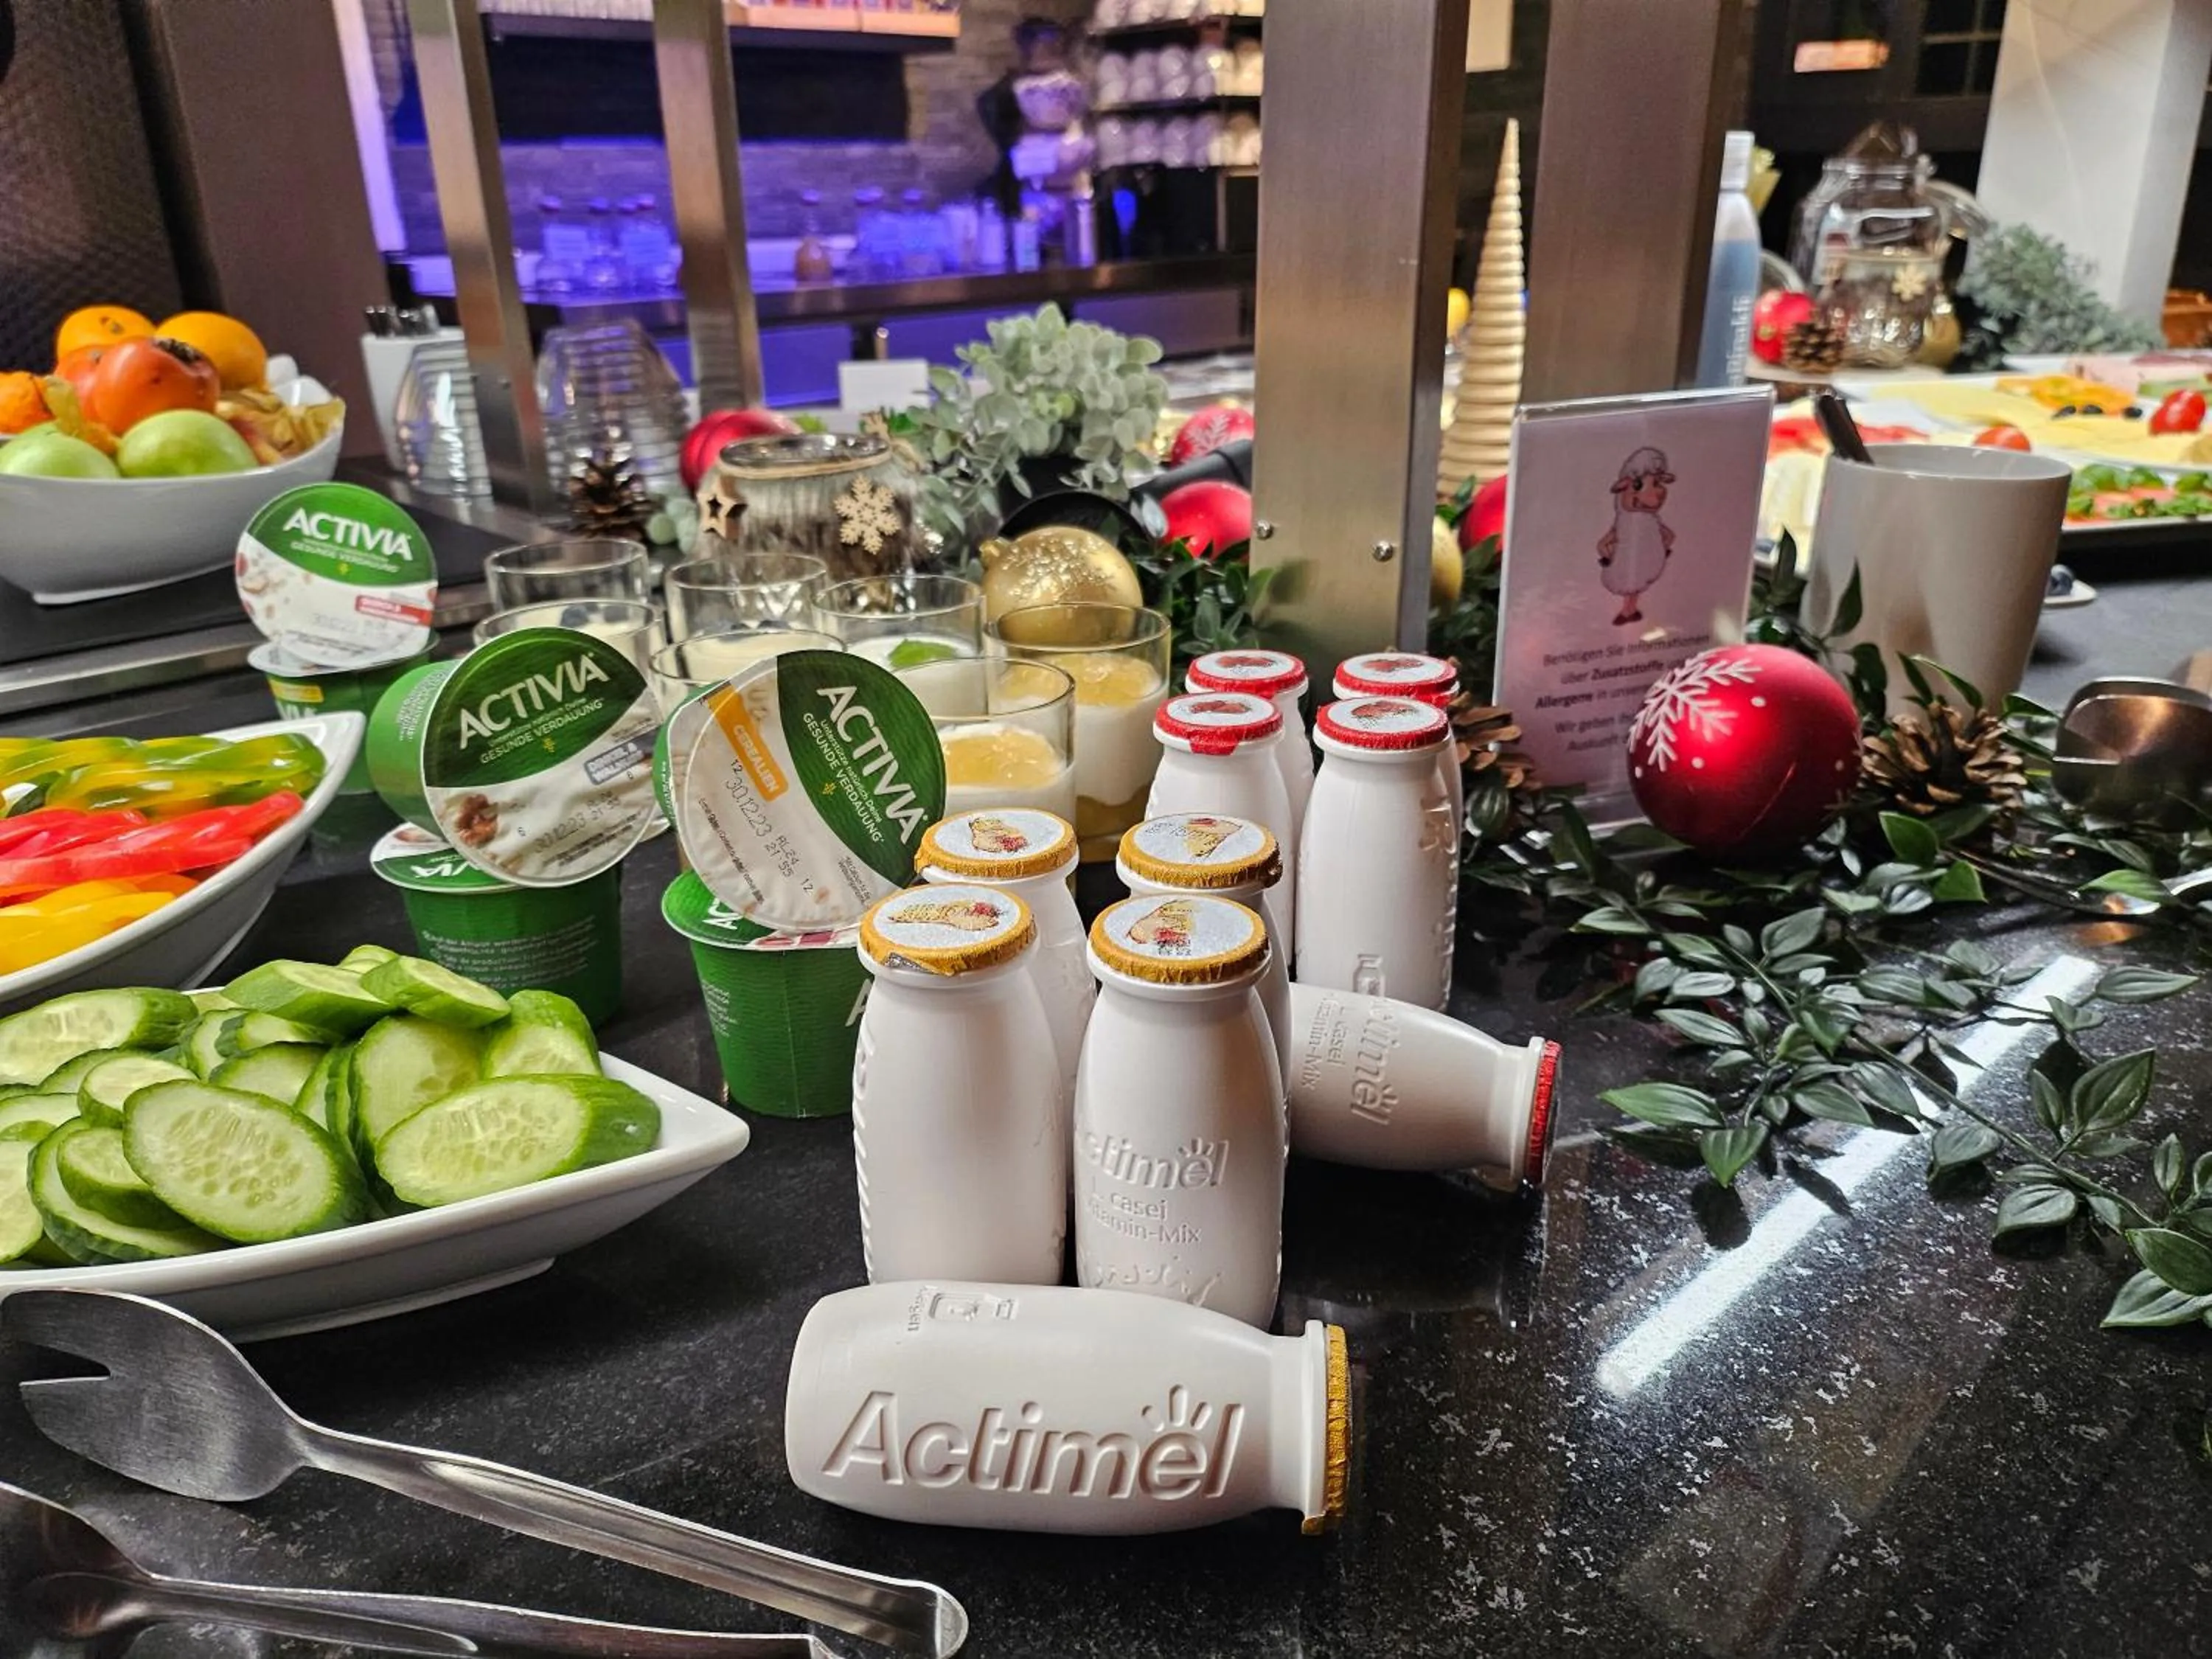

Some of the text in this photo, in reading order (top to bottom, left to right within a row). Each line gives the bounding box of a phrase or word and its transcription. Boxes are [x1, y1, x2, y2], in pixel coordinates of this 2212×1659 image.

[283, 507, 413, 561] ACTIVIA
[460, 654, 609, 749] ACTIVIA
[481, 731, 533, 764] GESUNDE
[734, 725, 779, 794] CEREALIEN
[803, 713, 841, 773] GESUNDE
[817, 685, 926, 845] ACTIVIA
[1084, 1137, 1230, 1190] ctimel
[1090, 1199, 1203, 1245] itamin-Mix
[1110, 1192, 1168, 1220] casei
[822, 1384, 1245, 1500] Actimel
